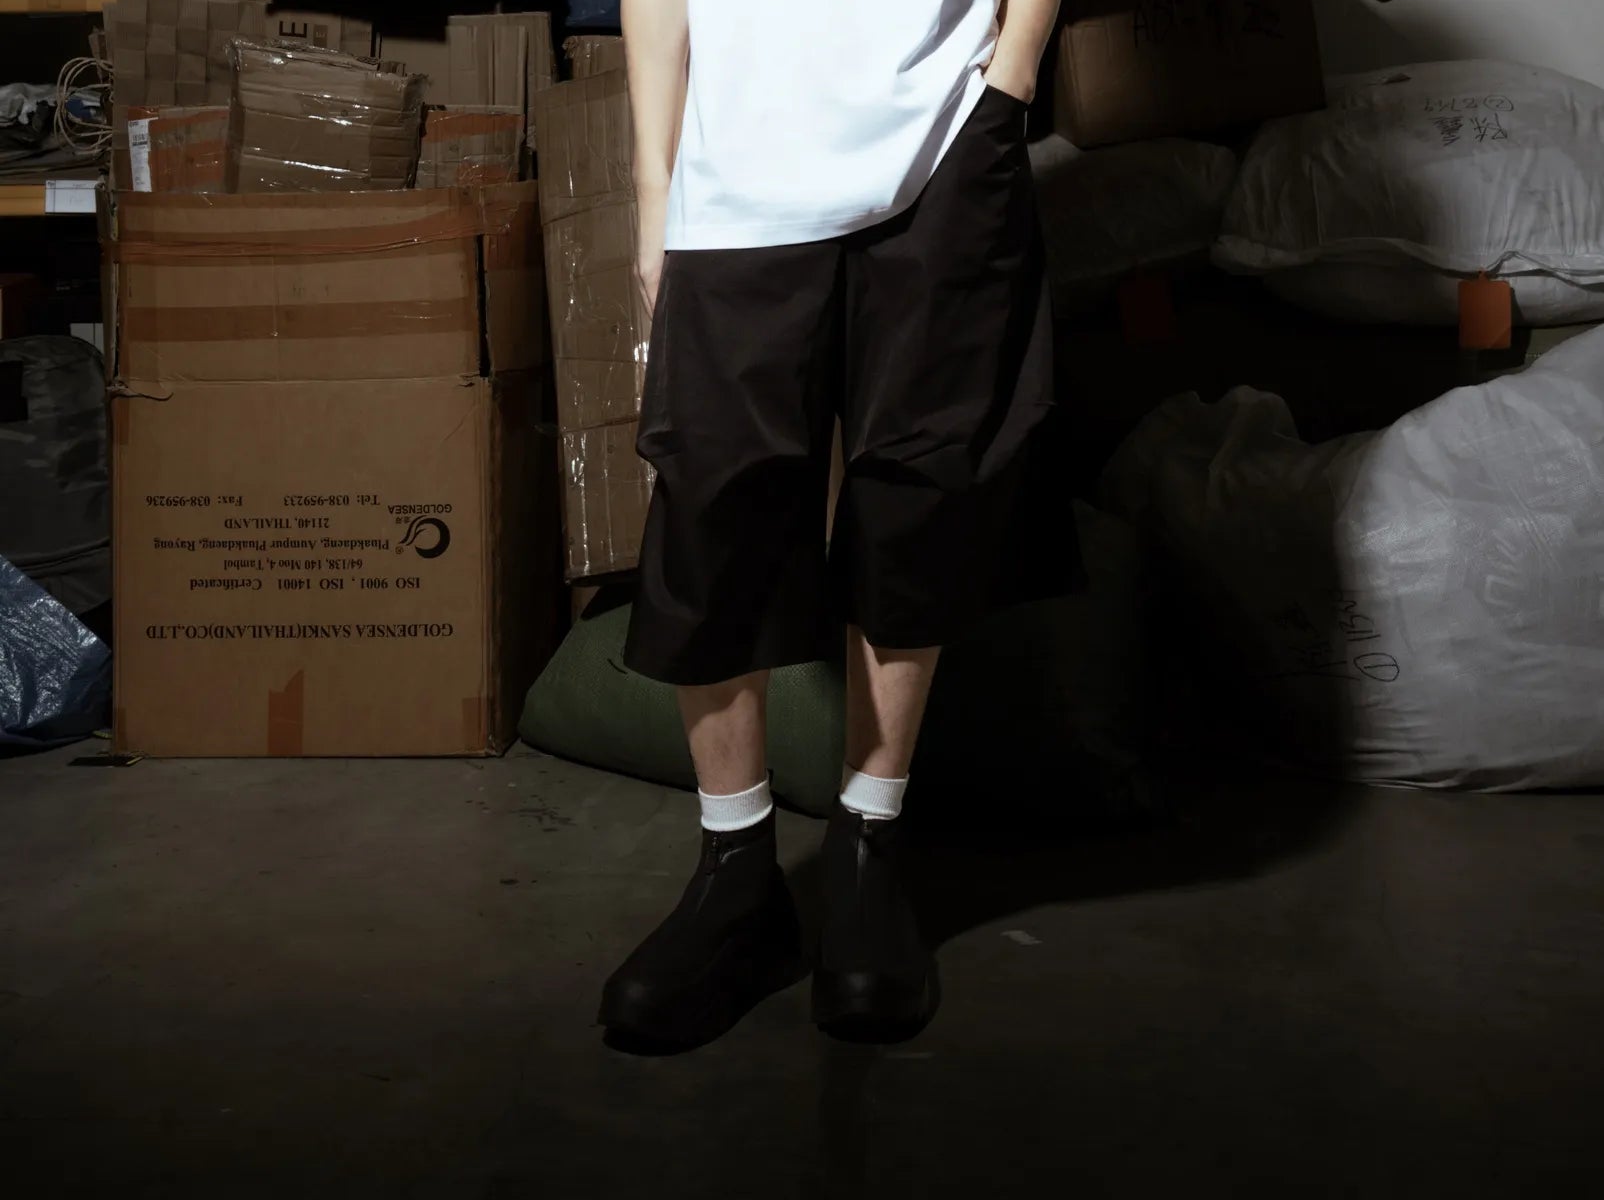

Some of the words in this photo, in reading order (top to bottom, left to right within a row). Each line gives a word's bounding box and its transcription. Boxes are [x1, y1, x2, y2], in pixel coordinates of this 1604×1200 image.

[143, 495, 211, 508] 038-959236
[217, 495, 244, 507] Fax:
[283, 495, 350, 508] 038-959233
[357, 495, 381, 507] Tel:
[387, 503, 453, 516] GOLDENSEA
[223, 517, 293, 530] THAILAND
[294, 516, 331, 529] 21140,
[152, 536, 196, 552] Rayong
[269, 536, 318, 551] Aumpur
[223, 559, 264, 572] Tambol
[279, 559, 302, 571] Moo
[304, 559, 323, 571] 140
[326, 557, 364, 572] 64/138,
[189, 576, 263, 592] Certificated
[277, 577, 312, 591] 14001
[319, 576, 345, 591] ISO
[396, 576, 421, 590] ISO
[356, 623, 454, 640] GOLDENSEA
